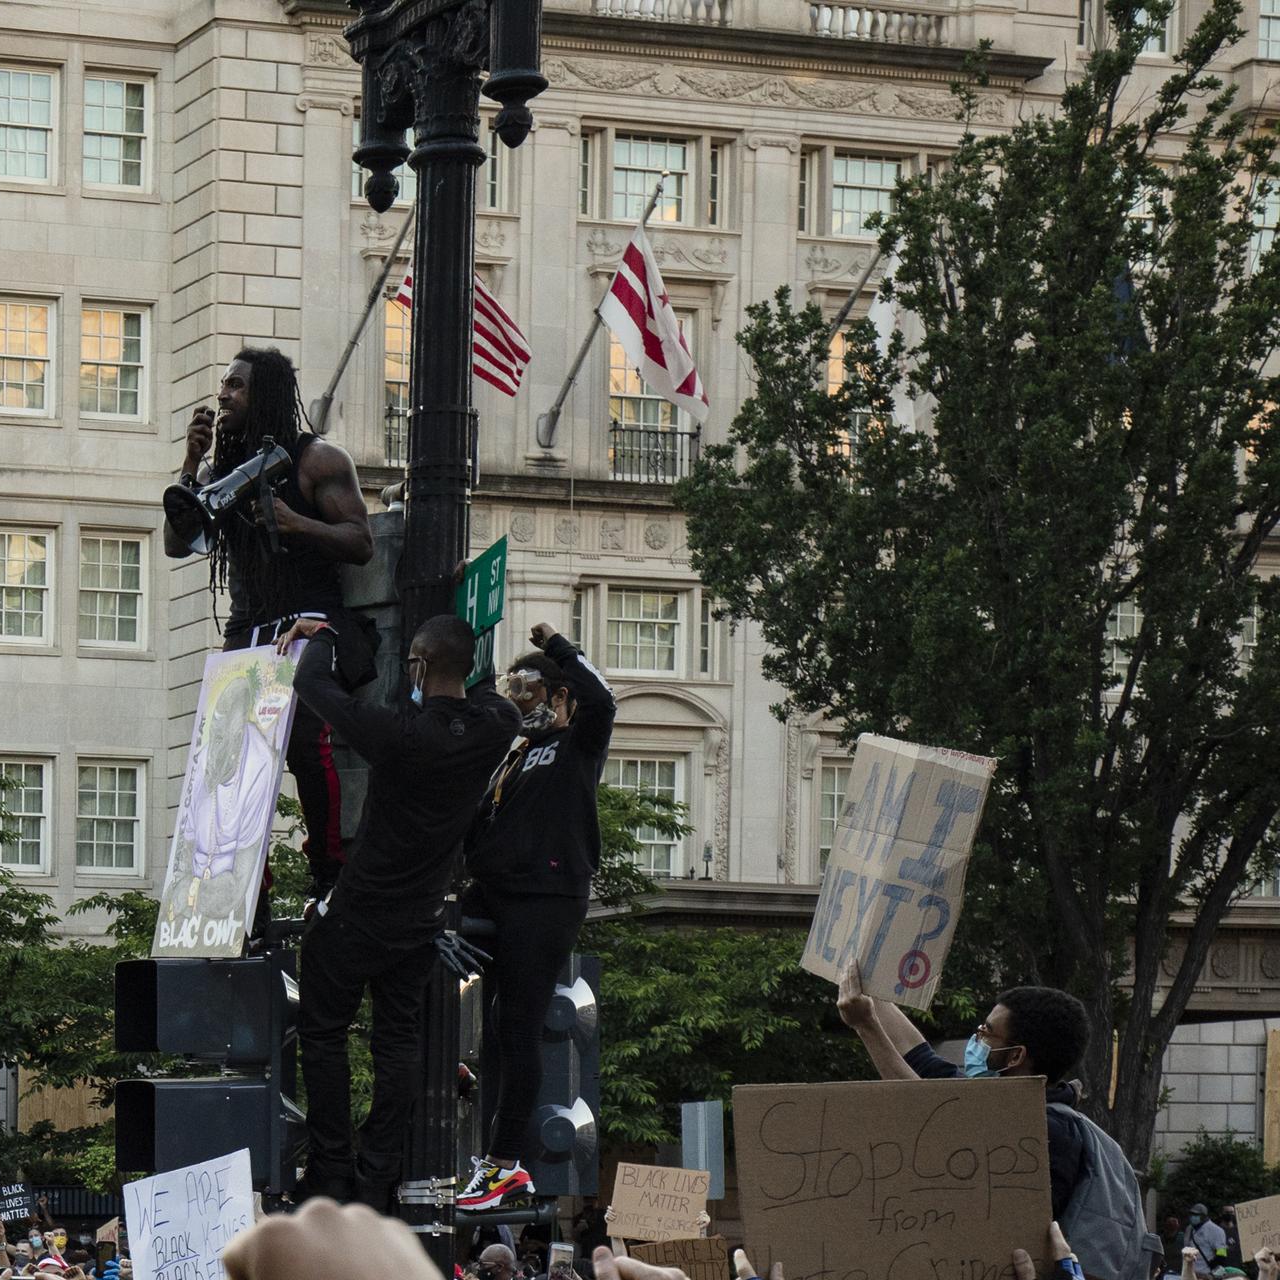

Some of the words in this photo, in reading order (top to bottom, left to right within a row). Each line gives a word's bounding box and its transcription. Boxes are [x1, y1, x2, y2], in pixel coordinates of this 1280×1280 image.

[490, 556, 502, 586] ST
[466, 571, 480, 630] H
[488, 586, 500, 616] NW
[842, 762, 918, 866] AM
[759, 1098, 904, 1213] Stop
[912, 1097, 1041, 1219] Cops
[1, 1183, 25, 1197] BLACK
[621, 1165, 671, 1190] BLACK
[673, 1173, 708, 1195] LIVES
[0, 1208, 30, 1222] MATTER
[5, 1196, 24, 1208] LIVES
[134, 1181, 171, 1240] WE
[184, 1166, 234, 1217] ARE
[638, 1190, 690, 1214] MATTER
[868, 1194, 957, 1235] from
[152, 1231, 198, 1268] BLACK
